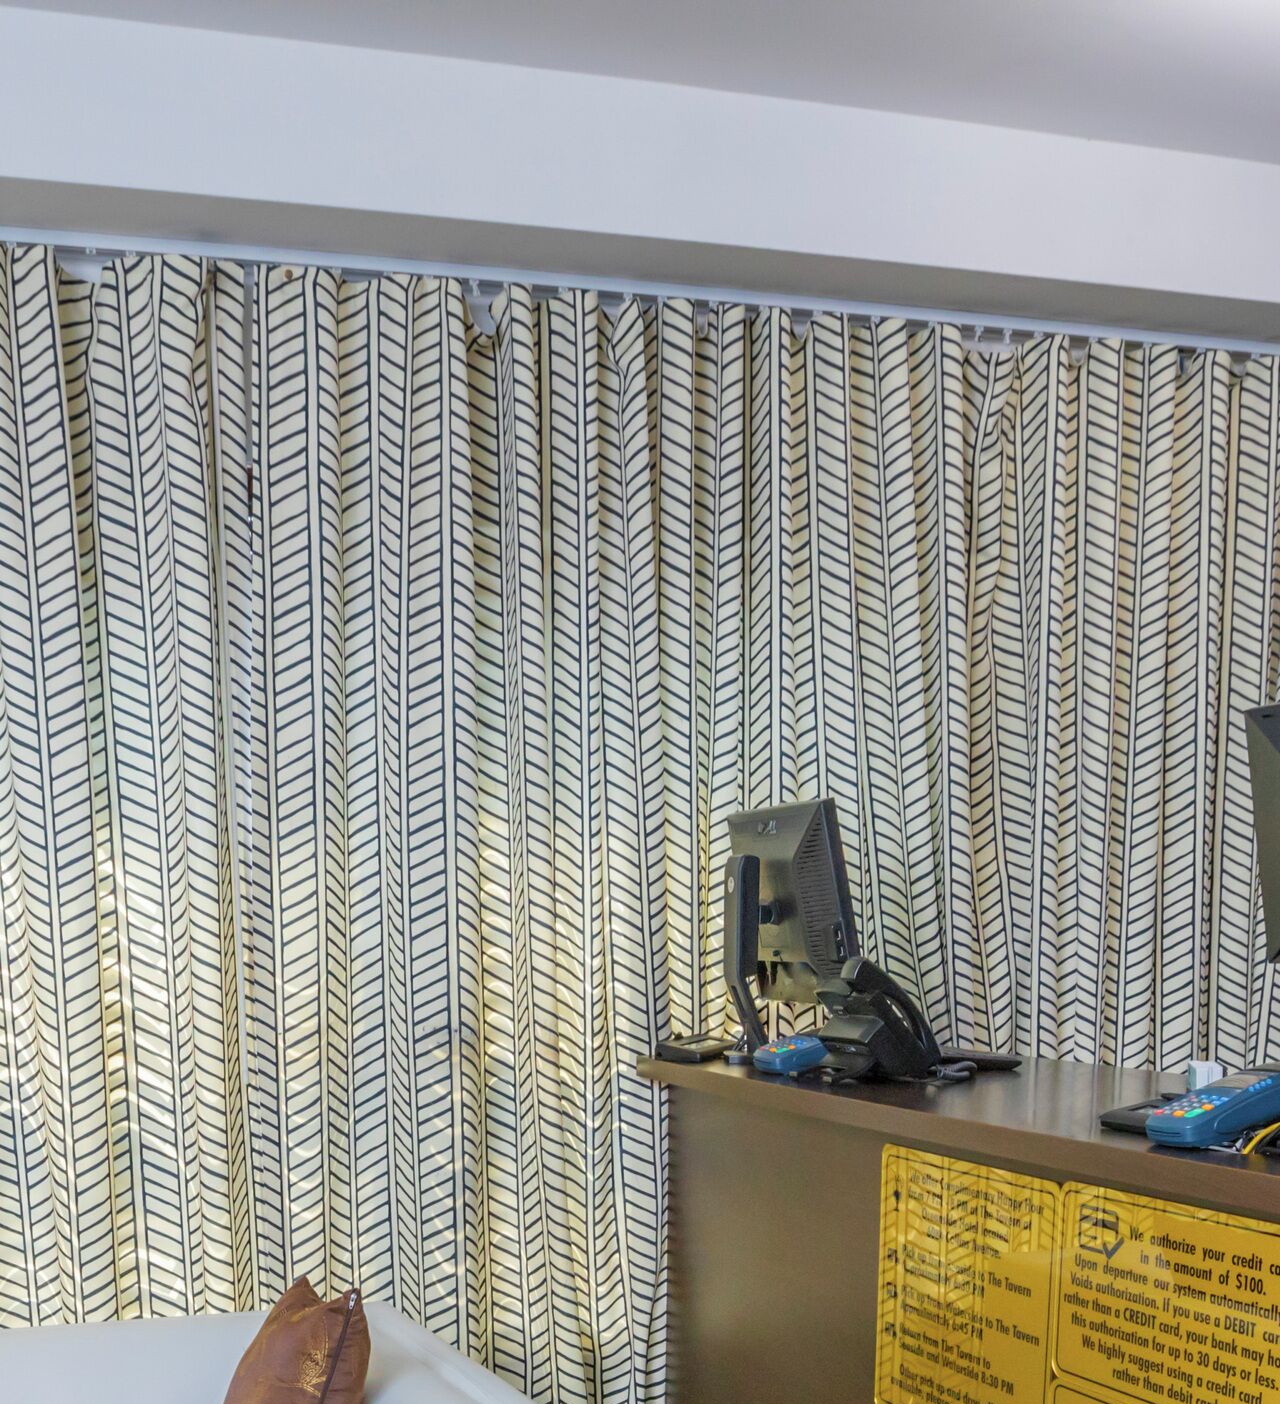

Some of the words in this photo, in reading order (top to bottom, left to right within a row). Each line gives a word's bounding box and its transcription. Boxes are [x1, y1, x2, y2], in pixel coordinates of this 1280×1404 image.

[970, 1204, 977, 1216] at
[980, 1205, 992, 1219] The
[996, 1210, 1020, 1228] Tavern
[1023, 1218, 1031, 1231] at
[1130, 1225, 1144, 1242] We
[1150, 1233, 1196, 1256] authorize
[1202, 1247, 1225, 1262] your
[1232, 1253, 1262, 1272] credit
[972, 1282, 984, 1298] PM
[977, 1268, 985, 1282] to
[988, 1271, 1002, 1288] The
[1005, 1276, 1032, 1298] Tavern
[1074, 1253, 1098, 1272] Upon
[1102, 1260, 1148, 1286] departure
[1154, 1278, 1170, 1292] our
[1172, 1283, 1206, 1302] system
[1140, 1250, 1149, 1265] in
[1155, 1254, 1170, 1270] the
[1173, 1262, 1212, 1281] amount
[1218, 1270, 1230, 1286] of
[1235, 1273, 1266, 1296] $100.
[1070, 1271, 1093, 1290] Voids
[1095, 1282, 1159, 1310] authorization.
[1162, 1298, 1170, 1313] If
[1172, 1305, 1190, 1319] you
[1193, 1311, 1211, 1325] use
[1214, 1317, 1220, 1328] a
[1224, 1315, 1256, 1338] DEBIT
[952, 1318, 968, 1335] 6:45
[970, 1325, 982, 1341] PM
[985, 1315, 993, 1329] to
[995, 1318, 1009, 1335] The
[1012, 1324, 1039, 1346] Tavern
[1064, 1292, 1090, 1309] rather
[1092, 1298, 1112, 1316] than
[1114, 1309, 1120, 1319] a
[1123, 1307, 1156, 1330] CREDIT
[1158, 1322, 1182, 1340] card,
[1186, 1330, 1208, 1346] your
[1211, 1332, 1238, 1356] bank
[1241, 1347, 1264, 1367] may
[940, 1338, 953, 1354] The
[956, 1344, 980, 1366] Tavern
[982, 1357, 990, 1370] to
[1071, 1312, 1086, 1328] this
[1089, 1320, 1149, 1348] authorization
[1152, 1336, 1166, 1354] for
[1168, 1346, 1180, 1362] up
[1184, 1348, 1192, 1363] to
[1196, 1351, 1210, 1368] 30
[1212, 1356, 1236, 1377] days
[1240, 1369, 1251, 1382] or
[1254, 1368, 1279, 1391] less.
[1082, 1334, 1095, 1350] We
[1098, 1338, 1126, 1364] highly
[1128, 1354, 1164, 1374] suggest
[1167, 1366, 1193, 1388] using
[1196, 1377, 1203, 1388] a
[1206, 1380, 1236, 1399] credit
[919, 1371, 934, 1391] pick
[946, 1383, 960, 1400] and
[926, 1348, 939, 1364] and
[981, 1370, 998, 1389] 8:30
[1000, 1378, 1013, 1396] PM
[1112, 1368, 1140, 1386] rather
[1143, 1375, 1164, 1395] than
